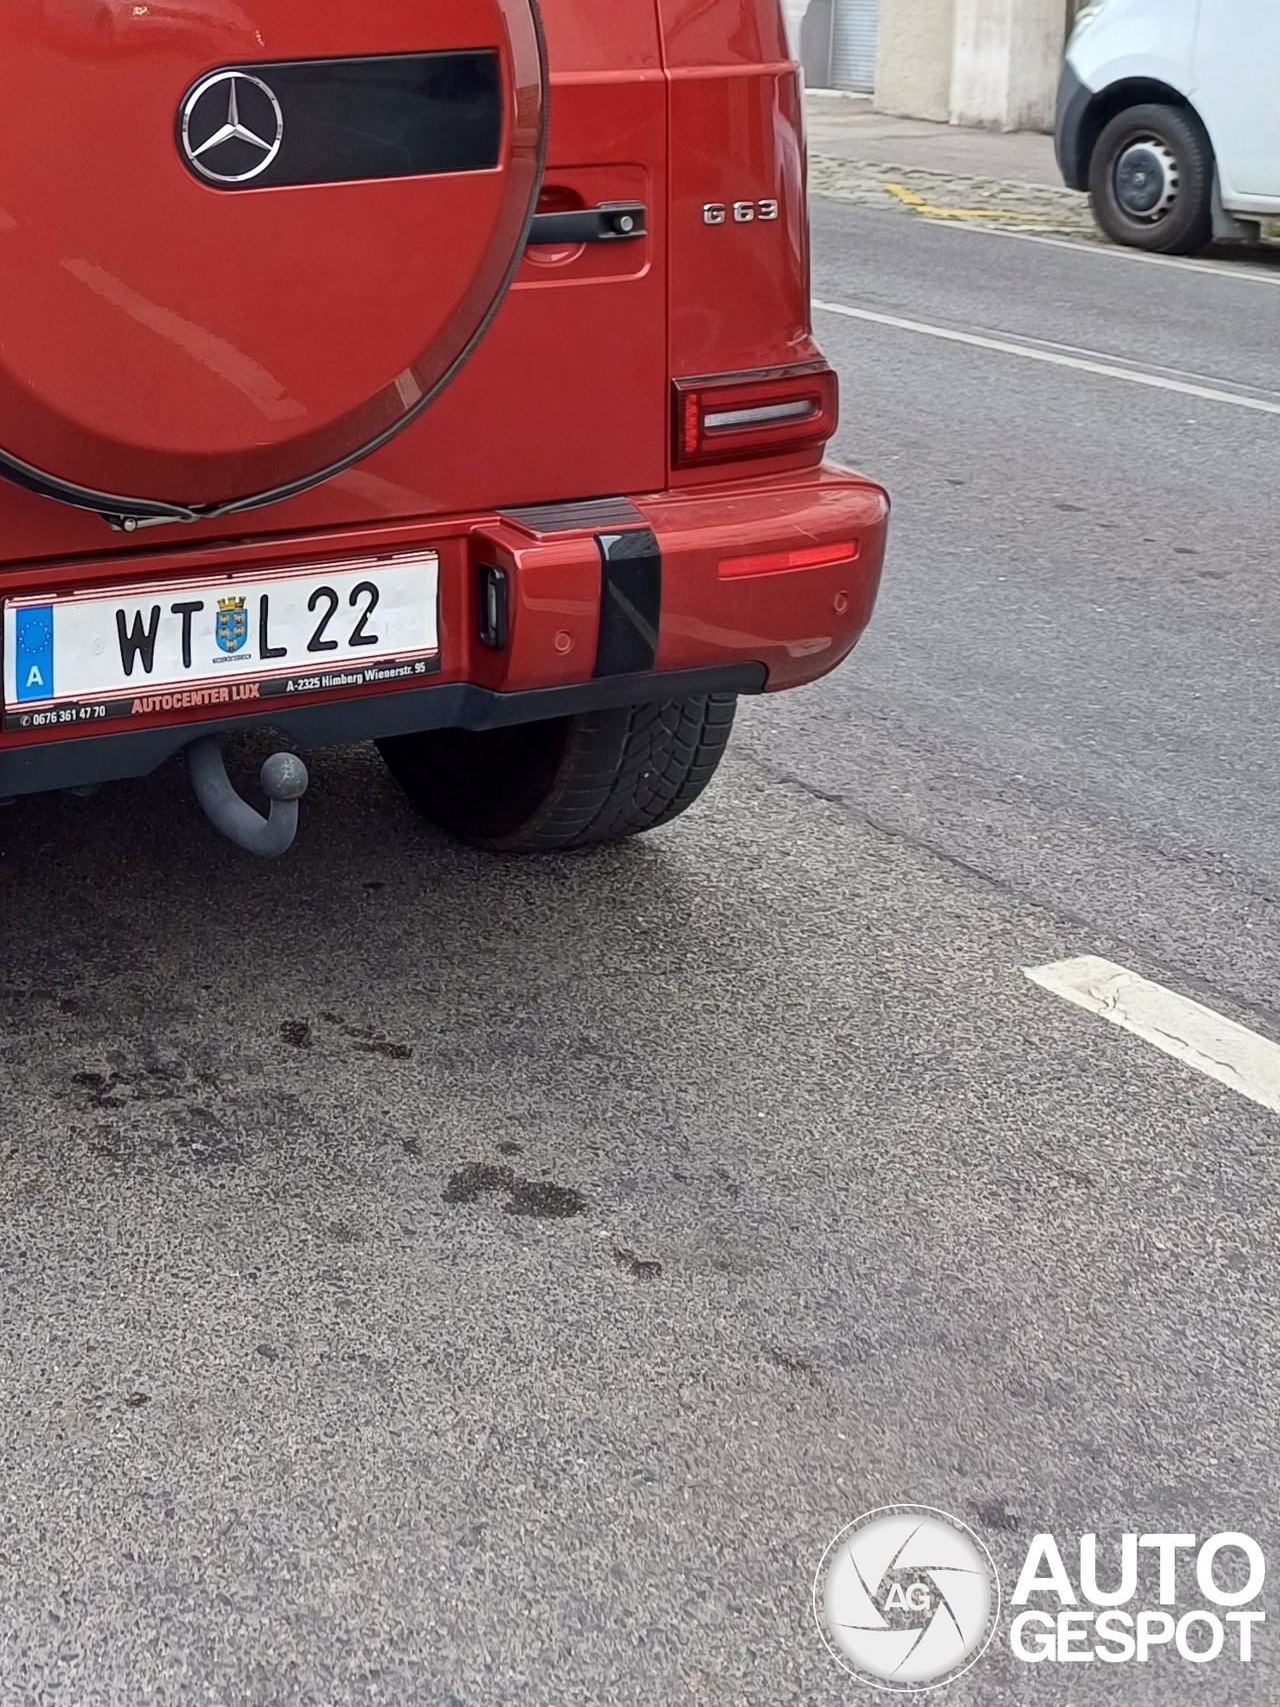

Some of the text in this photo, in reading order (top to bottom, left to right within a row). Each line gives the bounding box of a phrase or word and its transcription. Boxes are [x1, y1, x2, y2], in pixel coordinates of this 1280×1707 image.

[703, 199, 778, 225] G 63
[115, 581, 380, 676] WT L 22
[25, 665, 44, 687] A
[286, 677, 320, 692] A-2325
[321, 672, 363, 688] Himberg
[364, 665, 413, 681] Wienerstr.
[131, 683, 260, 714] AUTOCENTER LUX
[33, 705, 106, 726] 0676 361 47 70
